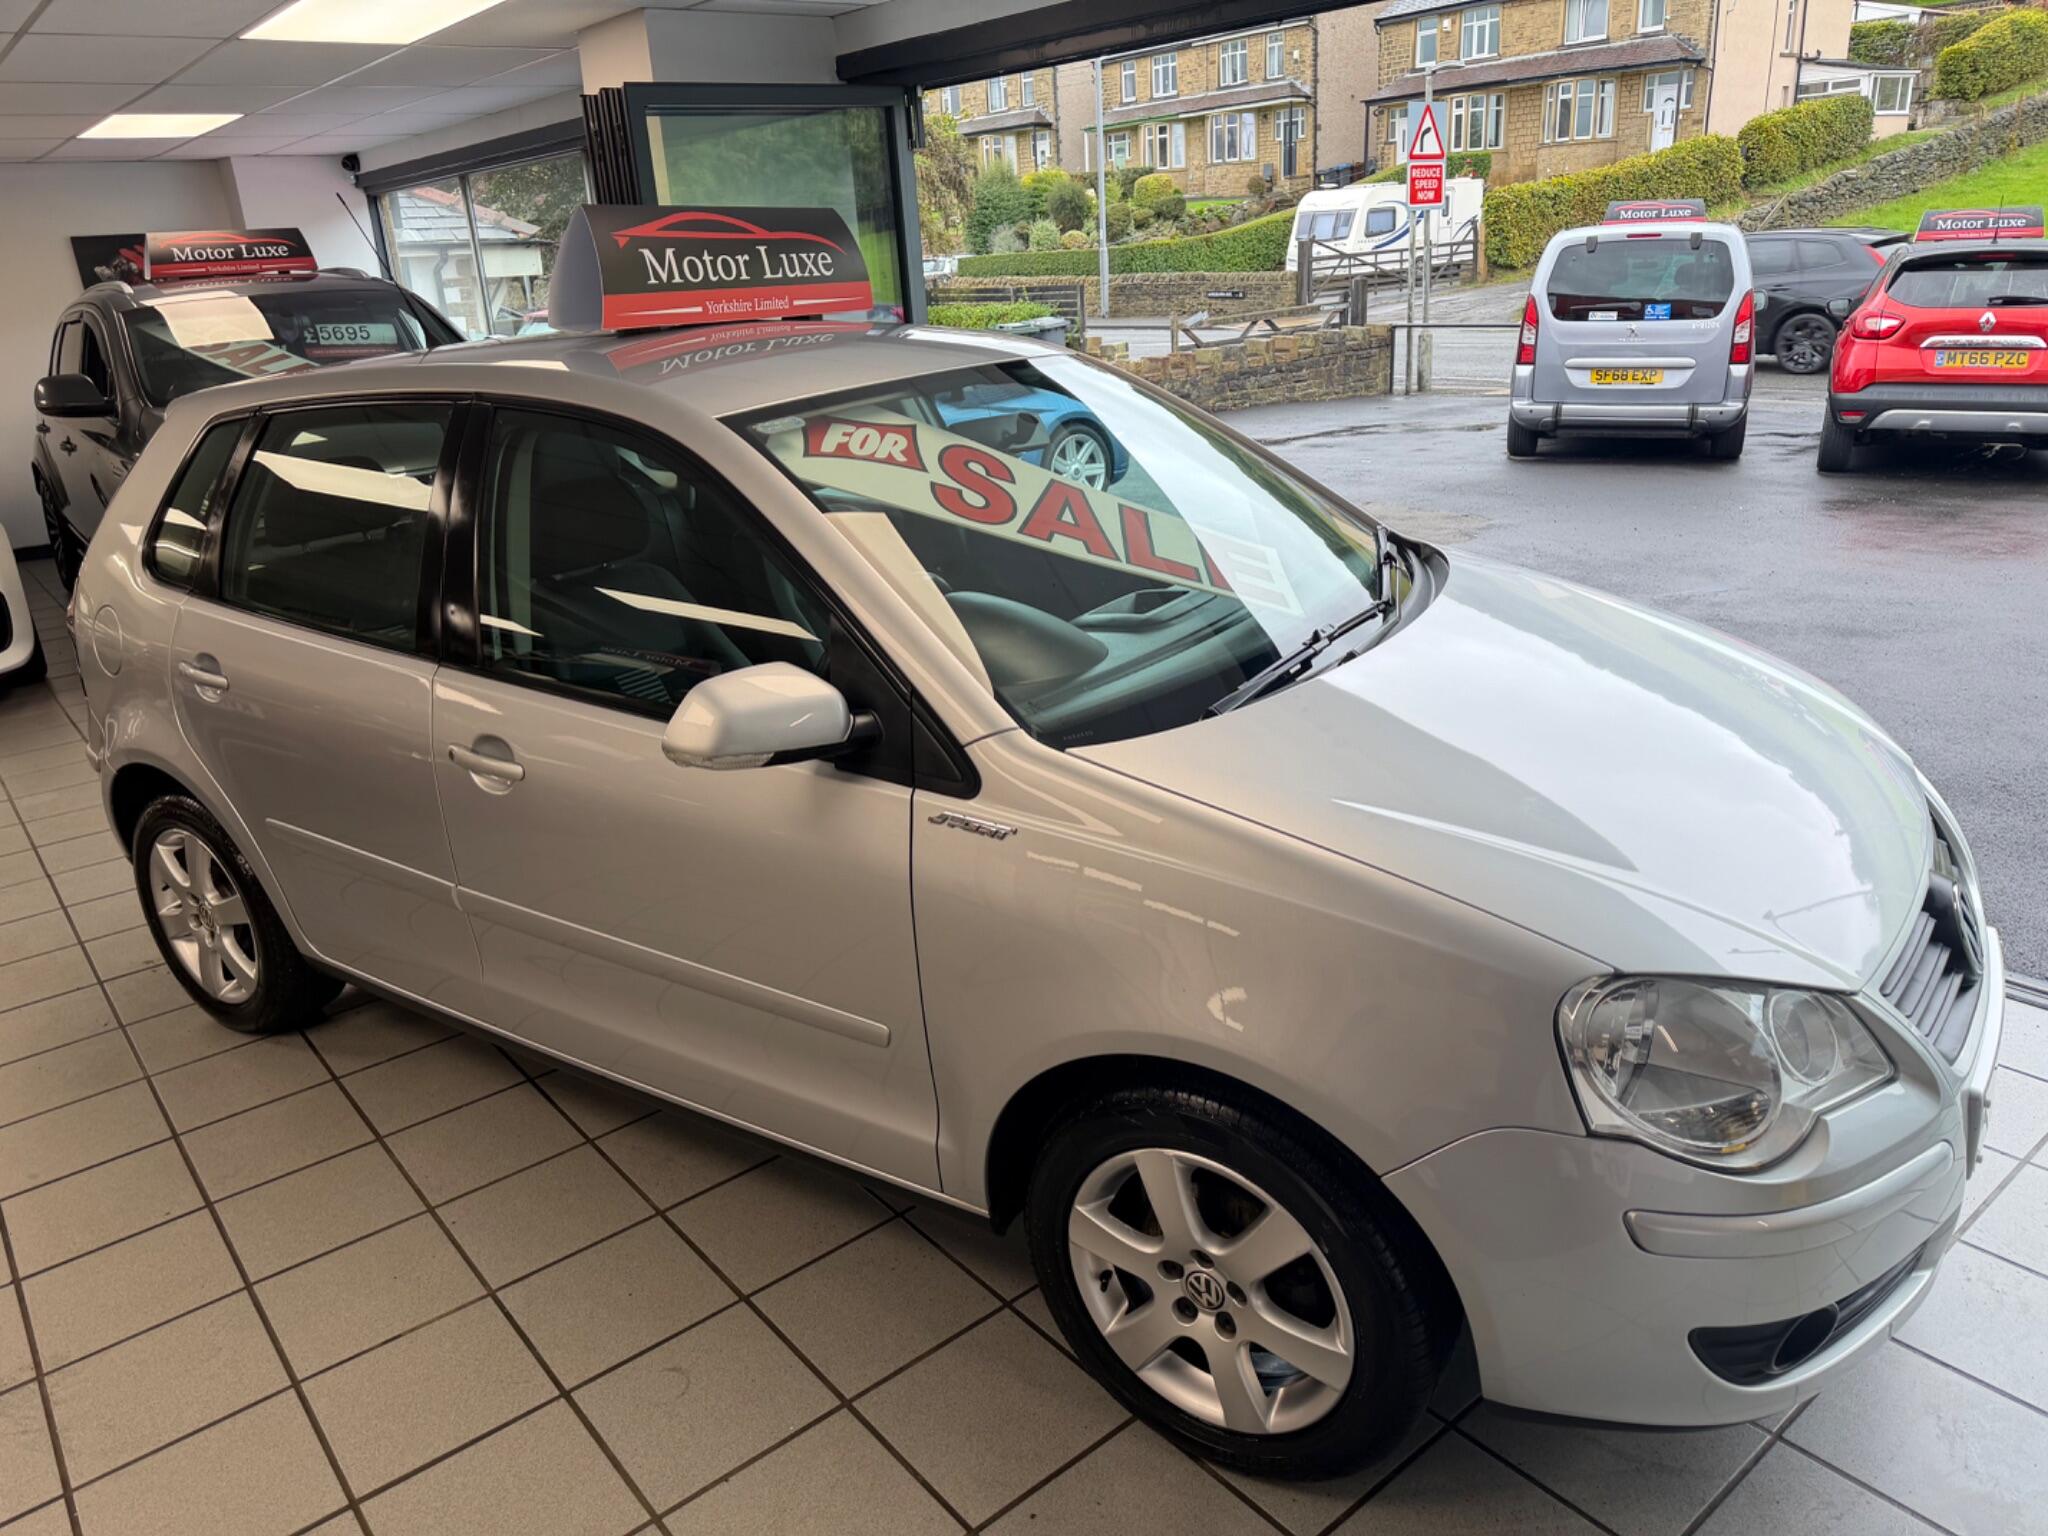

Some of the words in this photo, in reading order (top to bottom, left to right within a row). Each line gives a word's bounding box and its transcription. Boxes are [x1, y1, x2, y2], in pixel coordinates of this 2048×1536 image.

[1412, 168, 1441, 178] REDUCE
[1415, 179, 1438, 189] SPEED
[1417, 190, 1435, 200] NOW
[1620, 209, 1658, 220] Motor
[1661, 208, 1692, 218] Luxe
[1936, 219, 1984, 230] Motor
[1988, 217, 2027, 228] Luxe
[170, 247, 236, 262] Motor
[241, 244, 289, 258] Luxe
[638, 247, 751, 285] Motor
[755, 245, 834, 280] Luxe
[705, 299, 753, 314] Yorkshire
[754, 296, 790, 311] Limited
[1946, 351, 1990, 365] MT66
[1994, 351, 2028, 365] PZC
[1595, 369, 1629, 381] SF68
[1631, 369, 1657, 381] EXP
[821, 422, 909, 463] FOR
[929, 443, 1307, 618] SALE
[1187, 1271, 1224, 1310] VW
